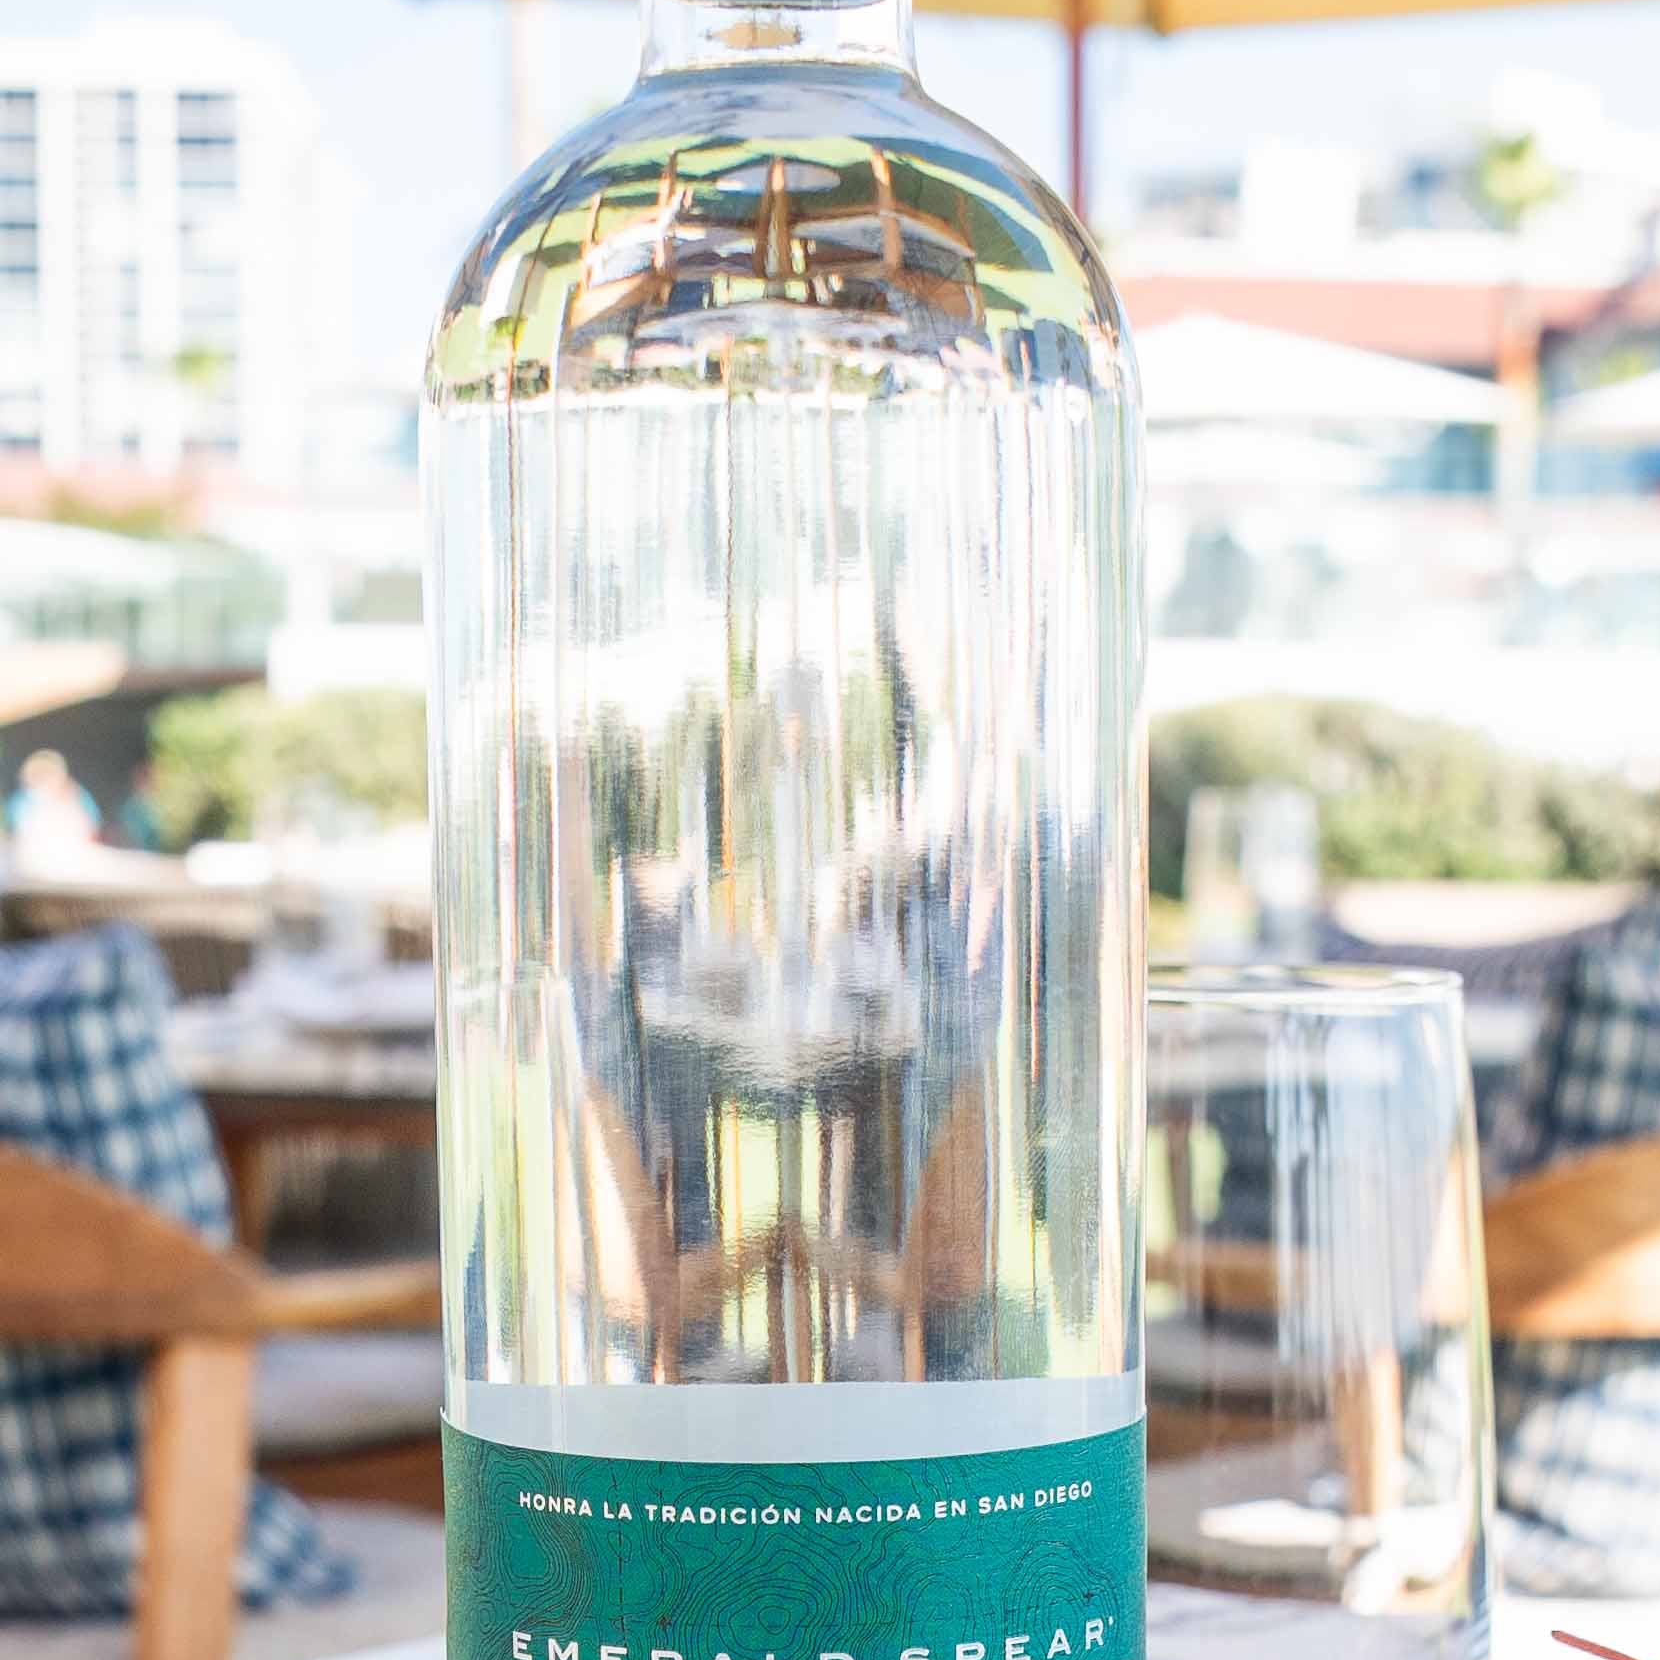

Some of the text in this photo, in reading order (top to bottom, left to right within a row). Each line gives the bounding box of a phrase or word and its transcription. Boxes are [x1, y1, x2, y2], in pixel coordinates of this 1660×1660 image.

[519, 1480, 1093, 1525] HONRA LA TRADICIÓN NACIDA EN SAN DIEGO
